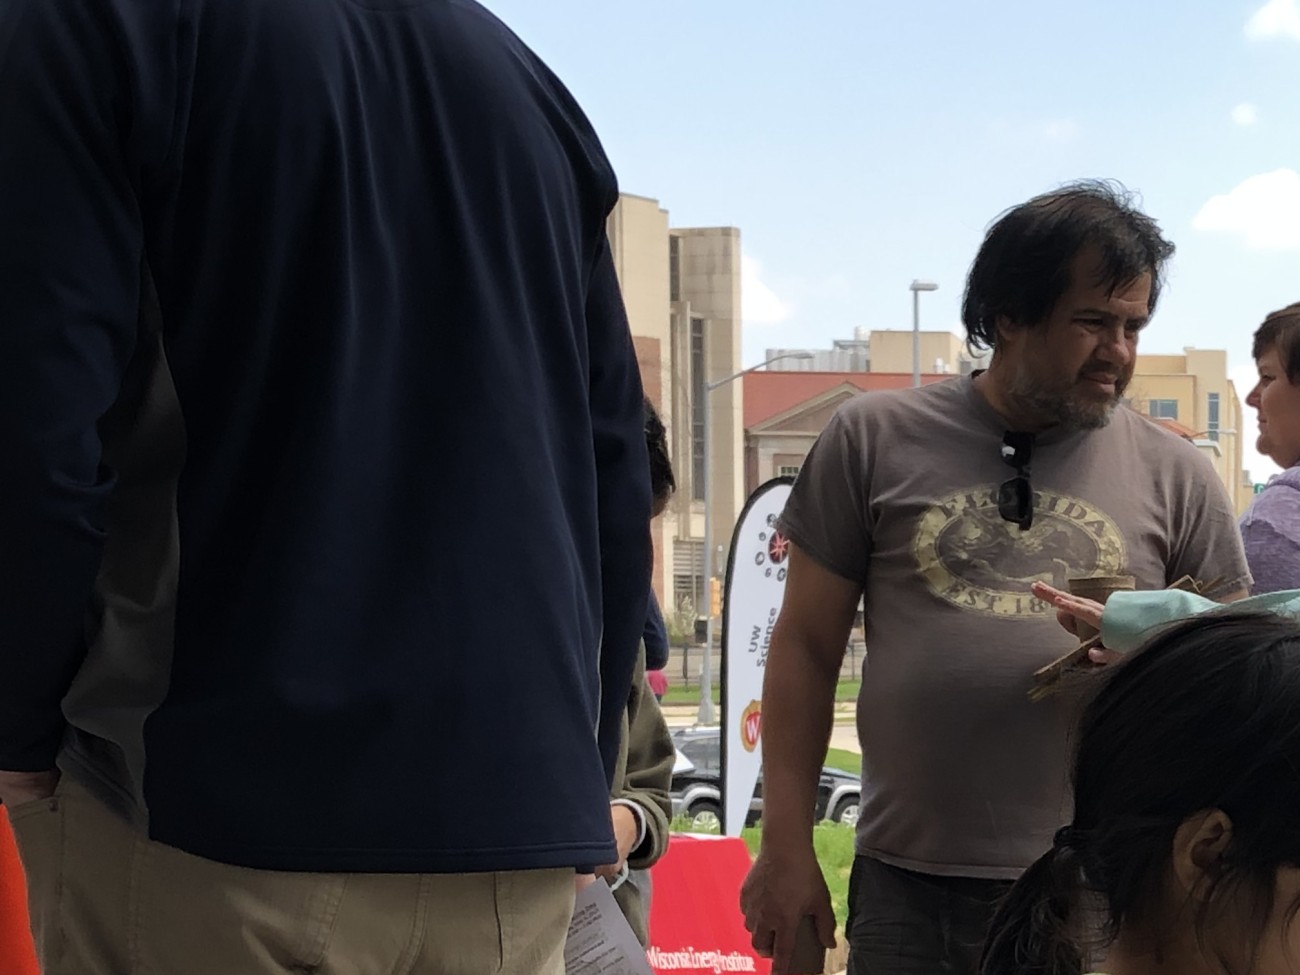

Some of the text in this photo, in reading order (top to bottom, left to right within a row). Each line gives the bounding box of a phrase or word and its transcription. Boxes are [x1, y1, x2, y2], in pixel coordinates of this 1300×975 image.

[748, 625, 761, 652] UW
[646, 945, 690, 969] Wisconsi
[688, 946, 721, 974] Energ
